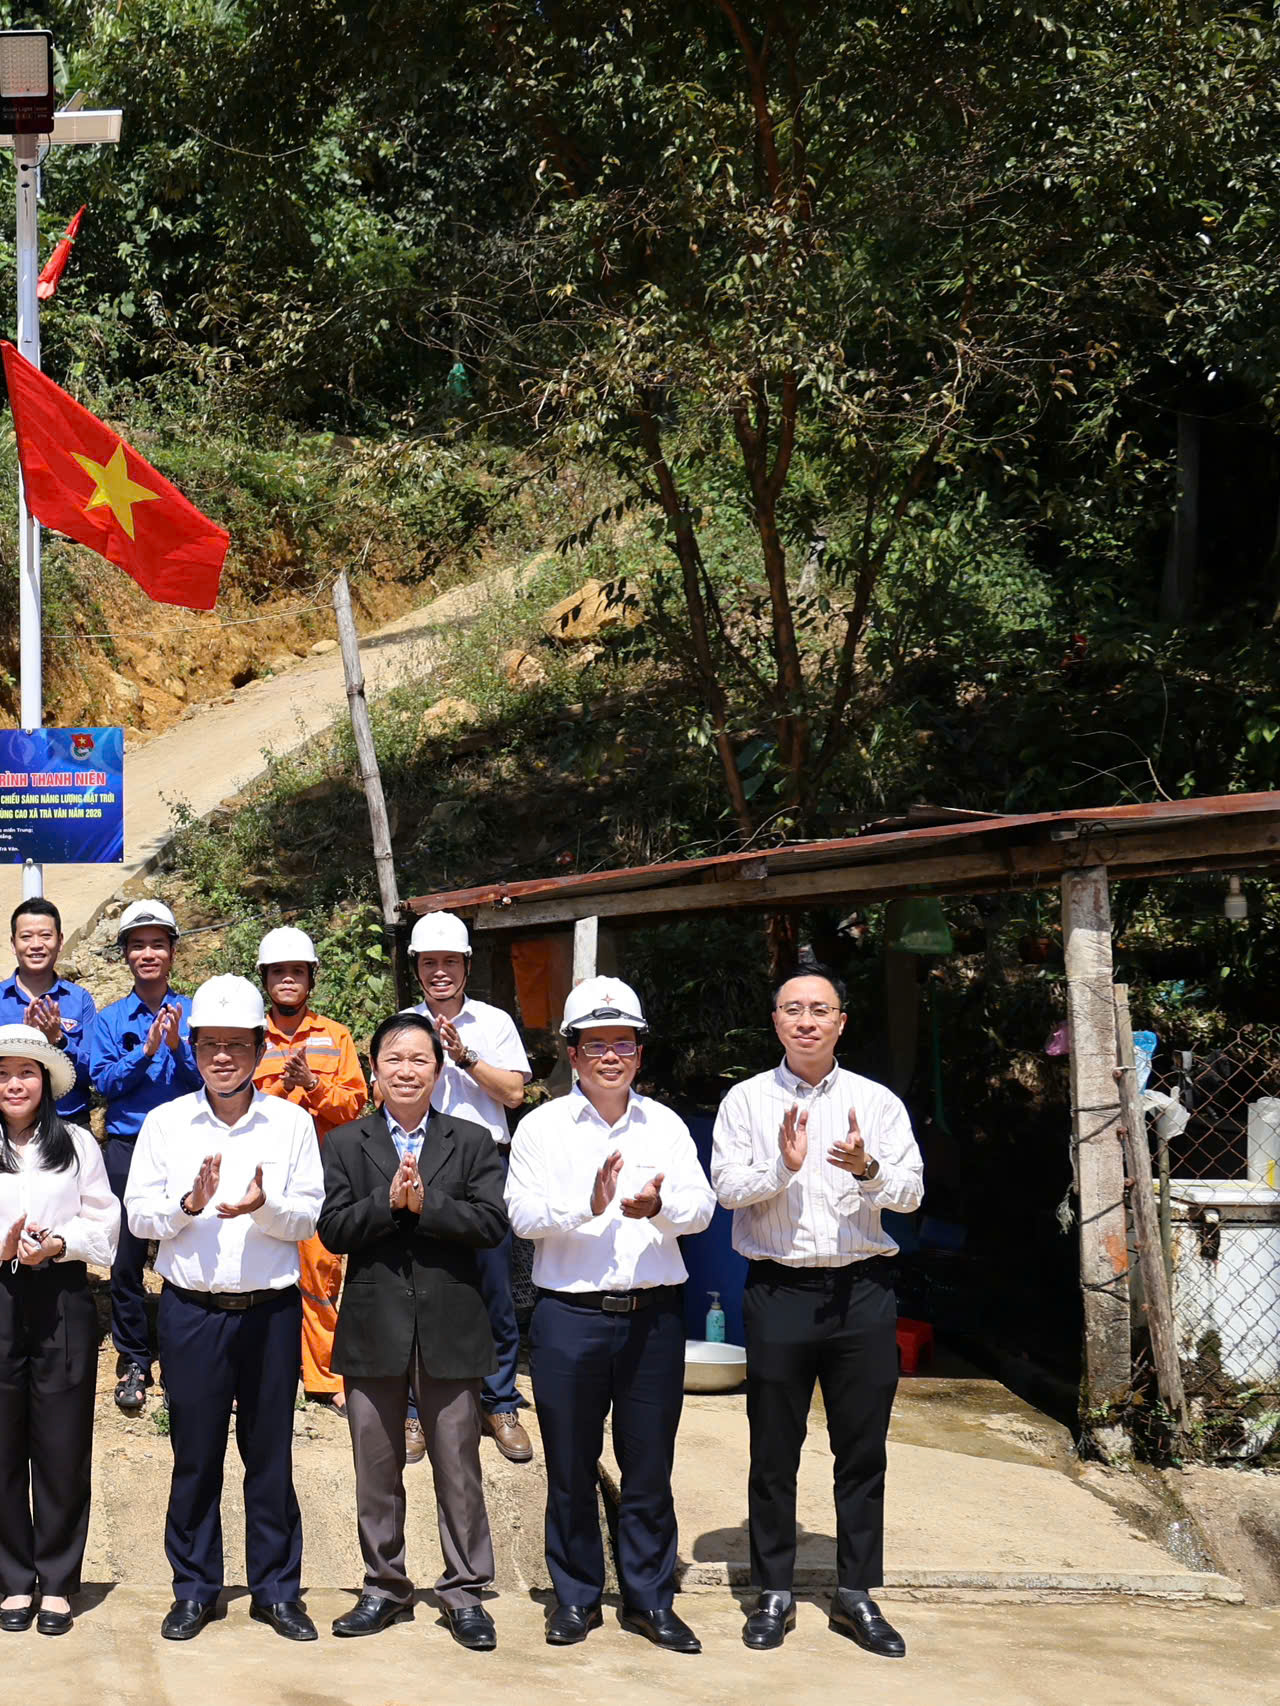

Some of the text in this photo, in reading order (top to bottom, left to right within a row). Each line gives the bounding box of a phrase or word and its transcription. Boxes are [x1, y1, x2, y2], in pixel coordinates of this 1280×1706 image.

[30, 772, 72, 787] THANH
[74, 769, 106, 786] NIÊN
[1, 792, 20, 804] CHIẾU
[21, 793, 39, 804] SÁNG
[40, 793, 59, 804] NĂNG
[100, 792, 115, 803] TRỜI
[15, 810, 28, 819] CAO
[29, 808, 38, 819] XÃ
[40, 807, 52, 818] TRÀ
[53, 807, 67, 818] VÂN
[68, 807, 84, 818] NĂM
[85, 809, 102, 818] 2026
